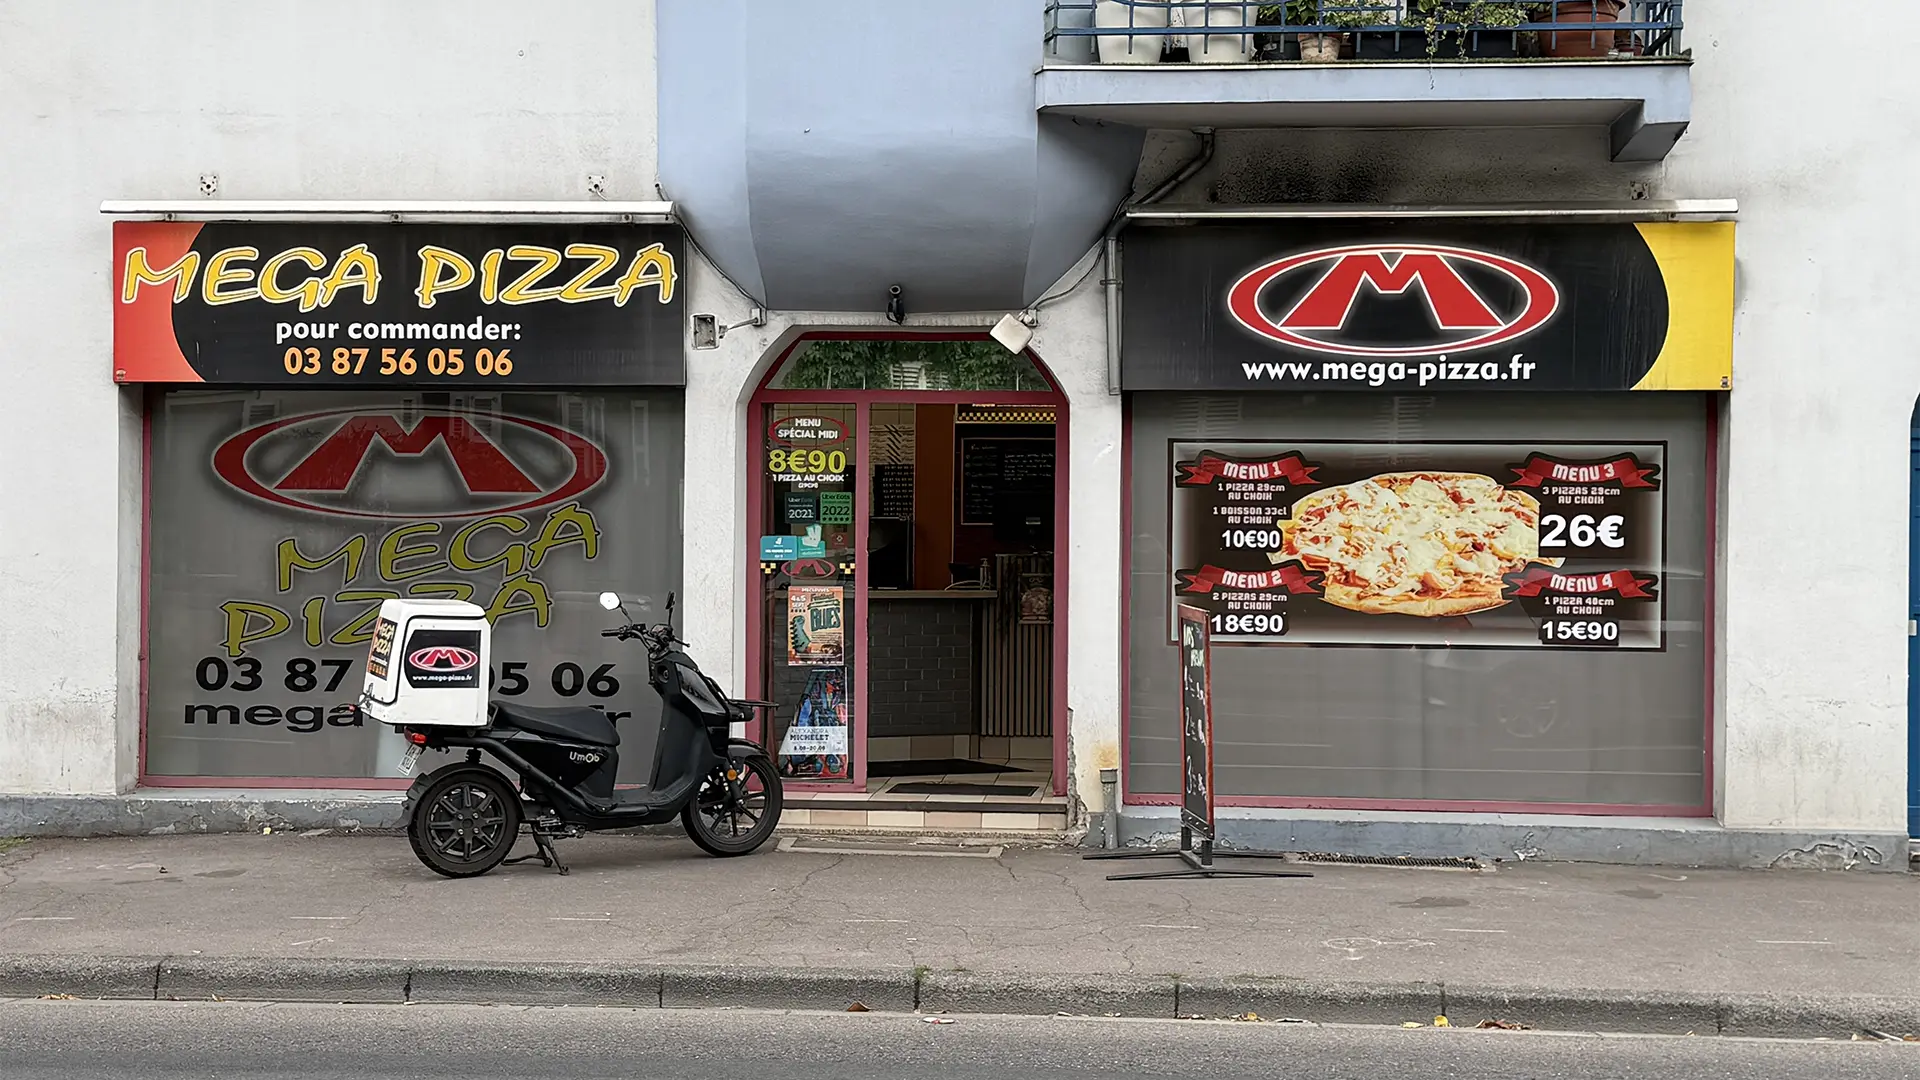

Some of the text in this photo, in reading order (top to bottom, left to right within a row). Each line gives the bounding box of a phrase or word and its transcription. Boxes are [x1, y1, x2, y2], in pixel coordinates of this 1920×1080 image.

[121, 244, 677, 311] MEGA PIZZA
[1279, 251, 1505, 329] M
[276, 316, 521, 344] pour commander:
[284, 347, 513, 376] 03 87 56 05 06
[1241, 354, 1536, 388] www.mega-pizza.fr
[795, 418, 821, 427] MENU
[777, 427, 838, 439] SPÉCIAL MIDI
[769, 450, 846, 474] 8€90
[1223, 461, 1282, 479] MENU 1
[772, 474, 777, 482] 1
[778, 474, 802, 482] PIZZA
[817, 474, 845, 482] CHOIX
[1552, 463, 1615, 482] MENU 3
[1218, 483, 1286, 492] 1 PIZZA 29cm
[1228, 492, 1272, 500] AU CHOIX
[1542, 487, 1620, 496] 3 PIZZAS 29cm
[1558, 496, 1604, 505] AU CHOIX
[788, 508, 814, 519] 2021
[822, 505, 850, 516] 2022
[1213, 506, 1287, 516] 1 BOISSON 33cl
[1228, 516, 1272, 524] AU CHOIX
[1222, 529, 1281, 548] 10€90
[1540, 514, 1625, 549] 26€
[277, 502, 600, 593] MEGA
[1222, 569, 1283, 589] MENU 2
[1549, 573, 1613, 592] MENU 4
[1212, 592, 1288, 602] 2 PIZZAS 29cm
[1228, 602, 1272, 610] AU CHOIX
[1544, 597, 1615, 606] 1 PIZZA 40cm
[810, 606, 841, 632] BLUES
[1556, 606, 1602, 615] AU CHOIX
[1211, 614, 1284, 633] 18€90
[1542, 620, 1618, 641] 15€90
[196, 656, 263, 692] 03
[284, 658, 354, 693] 87
[489, 662, 530, 696] 5
[551, 662, 620, 698] 06
